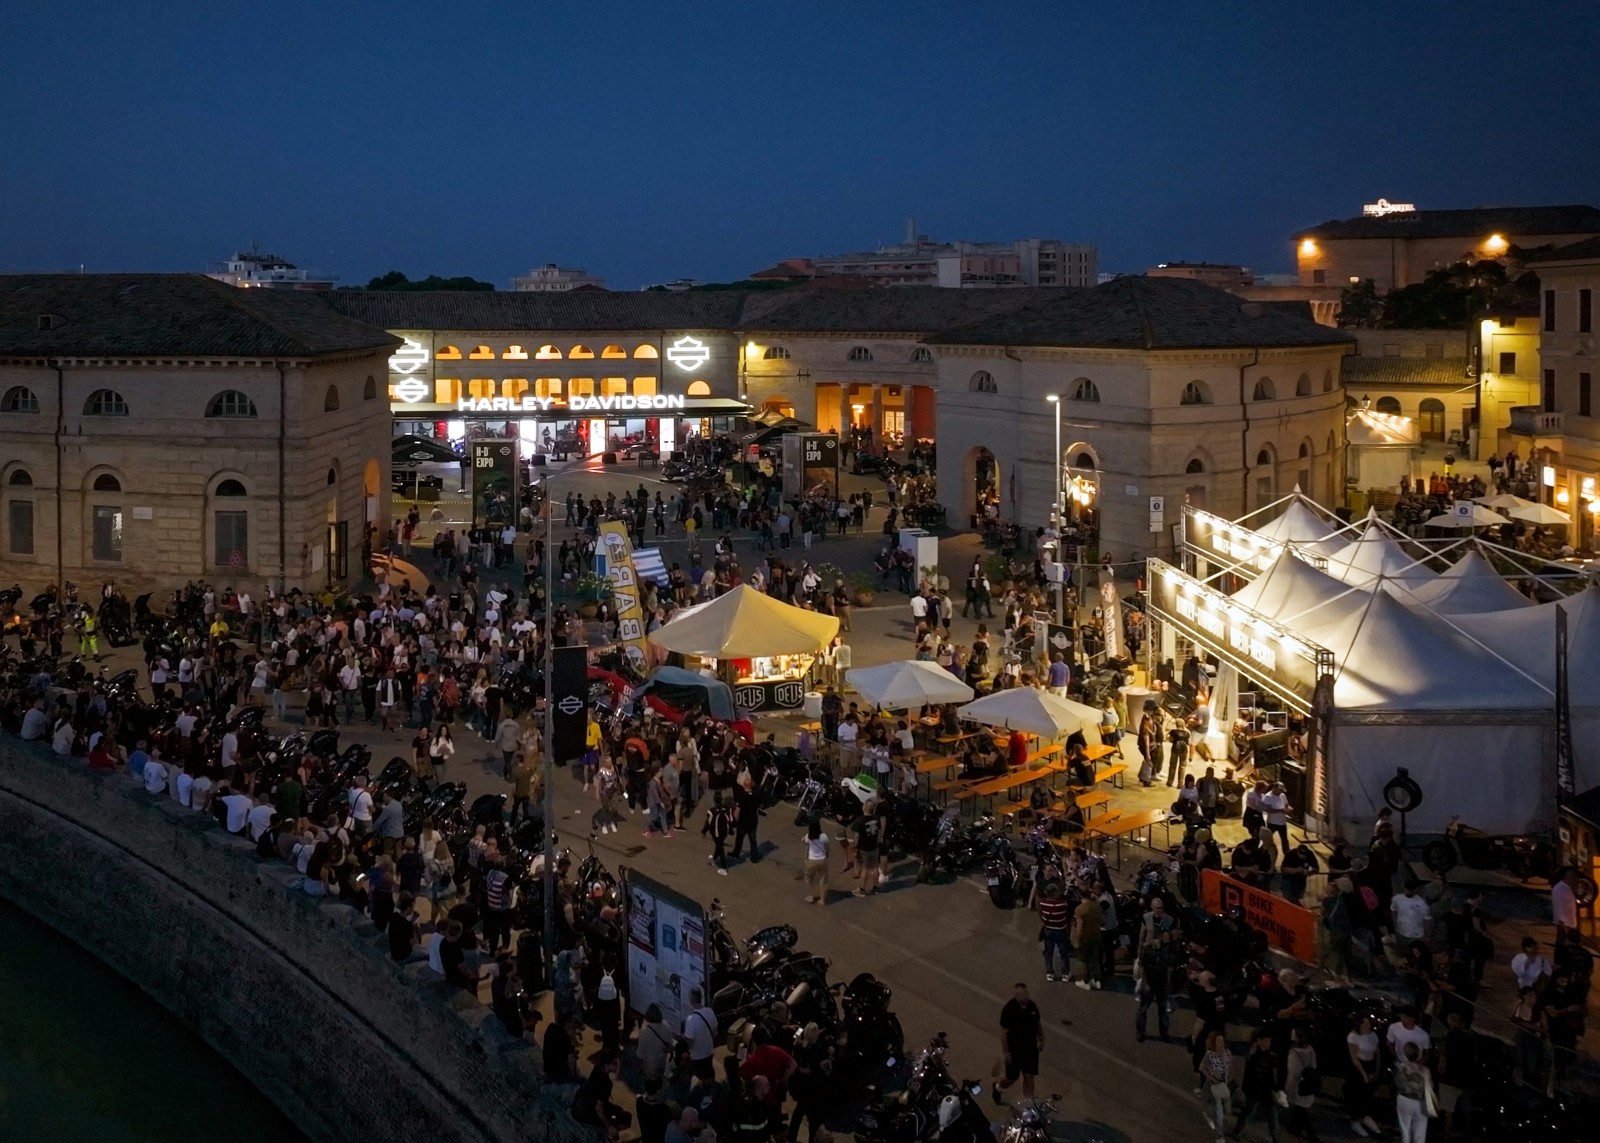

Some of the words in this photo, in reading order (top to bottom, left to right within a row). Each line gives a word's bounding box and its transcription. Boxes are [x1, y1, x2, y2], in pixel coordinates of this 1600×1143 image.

[476, 457, 494, 468] EXPO
[806, 451, 822, 461] EXPO
[736, 688, 762, 708] DEUS
[778, 684, 803, 703] DEUS
[1248, 892, 1274, 916] BIKE
[1248, 909, 1296, 944] PARKING
